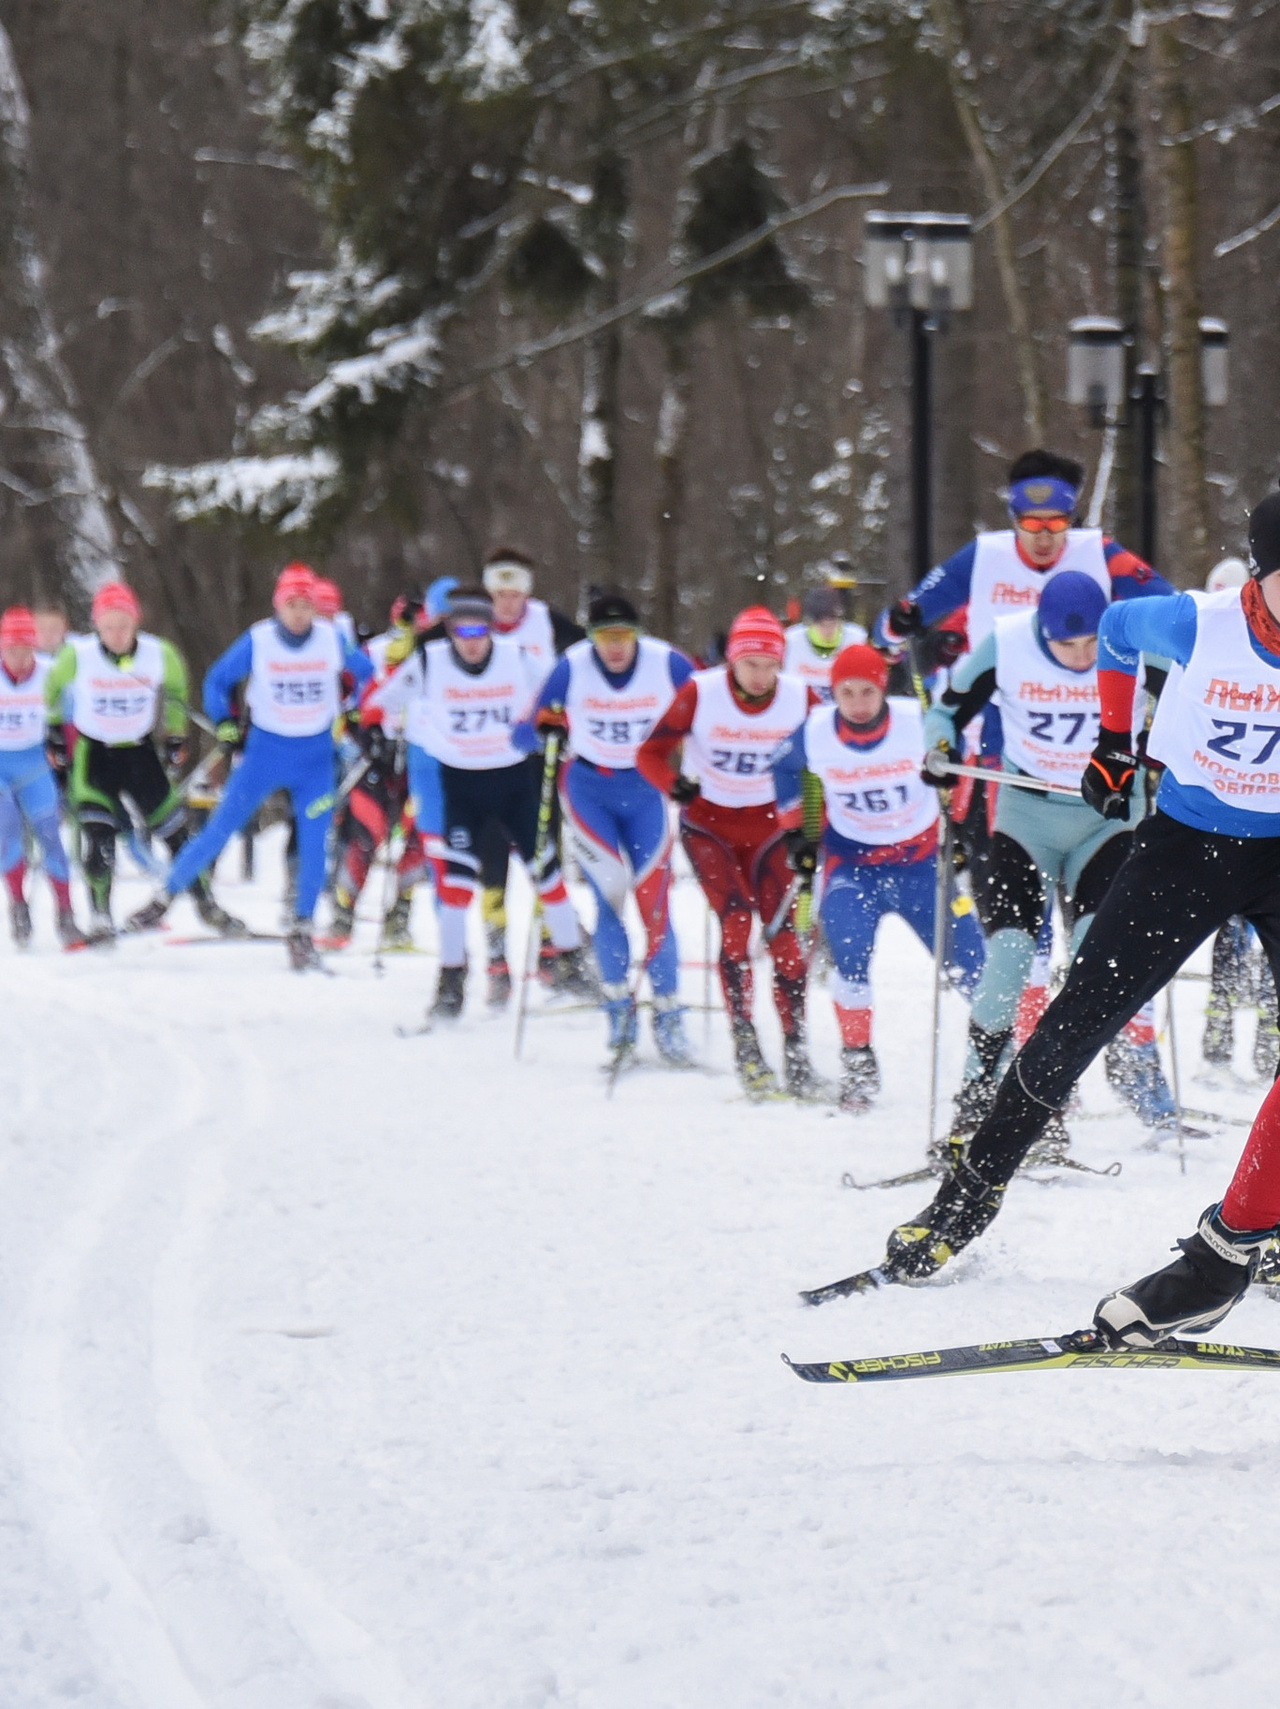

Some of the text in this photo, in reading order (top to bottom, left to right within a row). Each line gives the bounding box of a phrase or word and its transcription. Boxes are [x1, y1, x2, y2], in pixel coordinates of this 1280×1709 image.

[1197, 1342, 1246, 1358] SKATE
[854, 1351, 942, 1374] FISCHER
[1065, 1354, 1181, 1369] FISCHER
